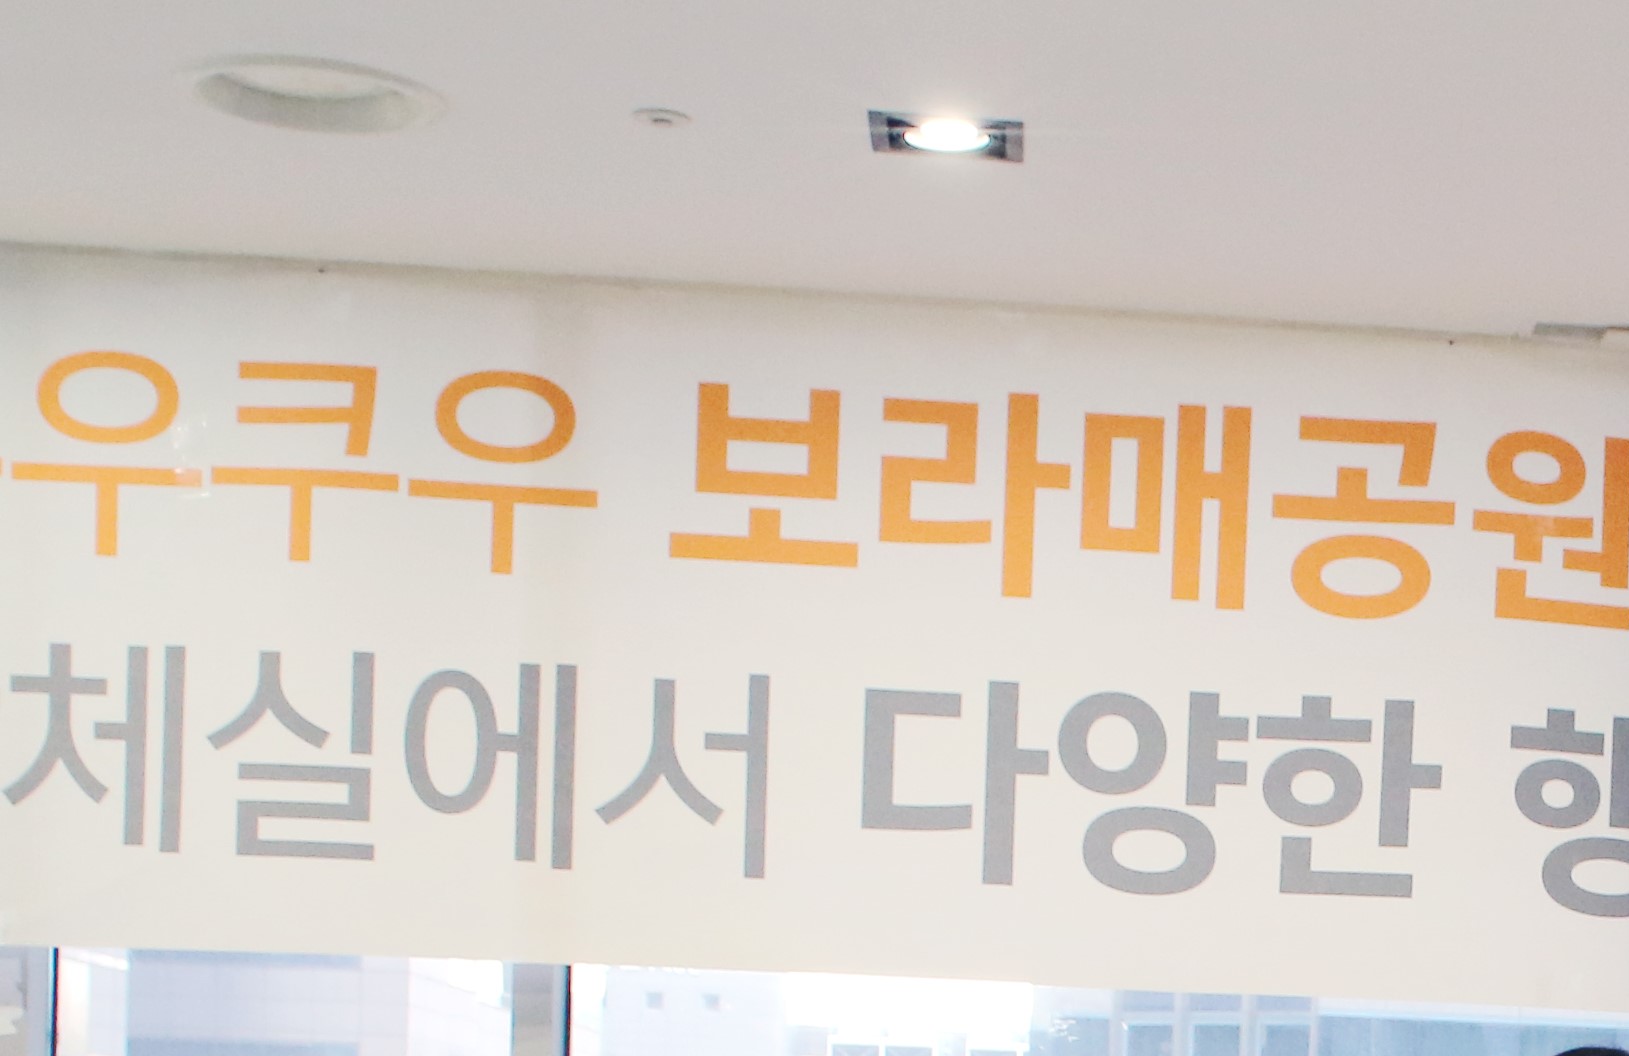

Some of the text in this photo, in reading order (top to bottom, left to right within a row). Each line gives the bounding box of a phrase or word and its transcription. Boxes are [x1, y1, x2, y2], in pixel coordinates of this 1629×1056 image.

[0, 350, 599, 575] 우쿠우
[3, 643, 771, 880] 체실에서
[861, 680, 1443, 899] 다양한
